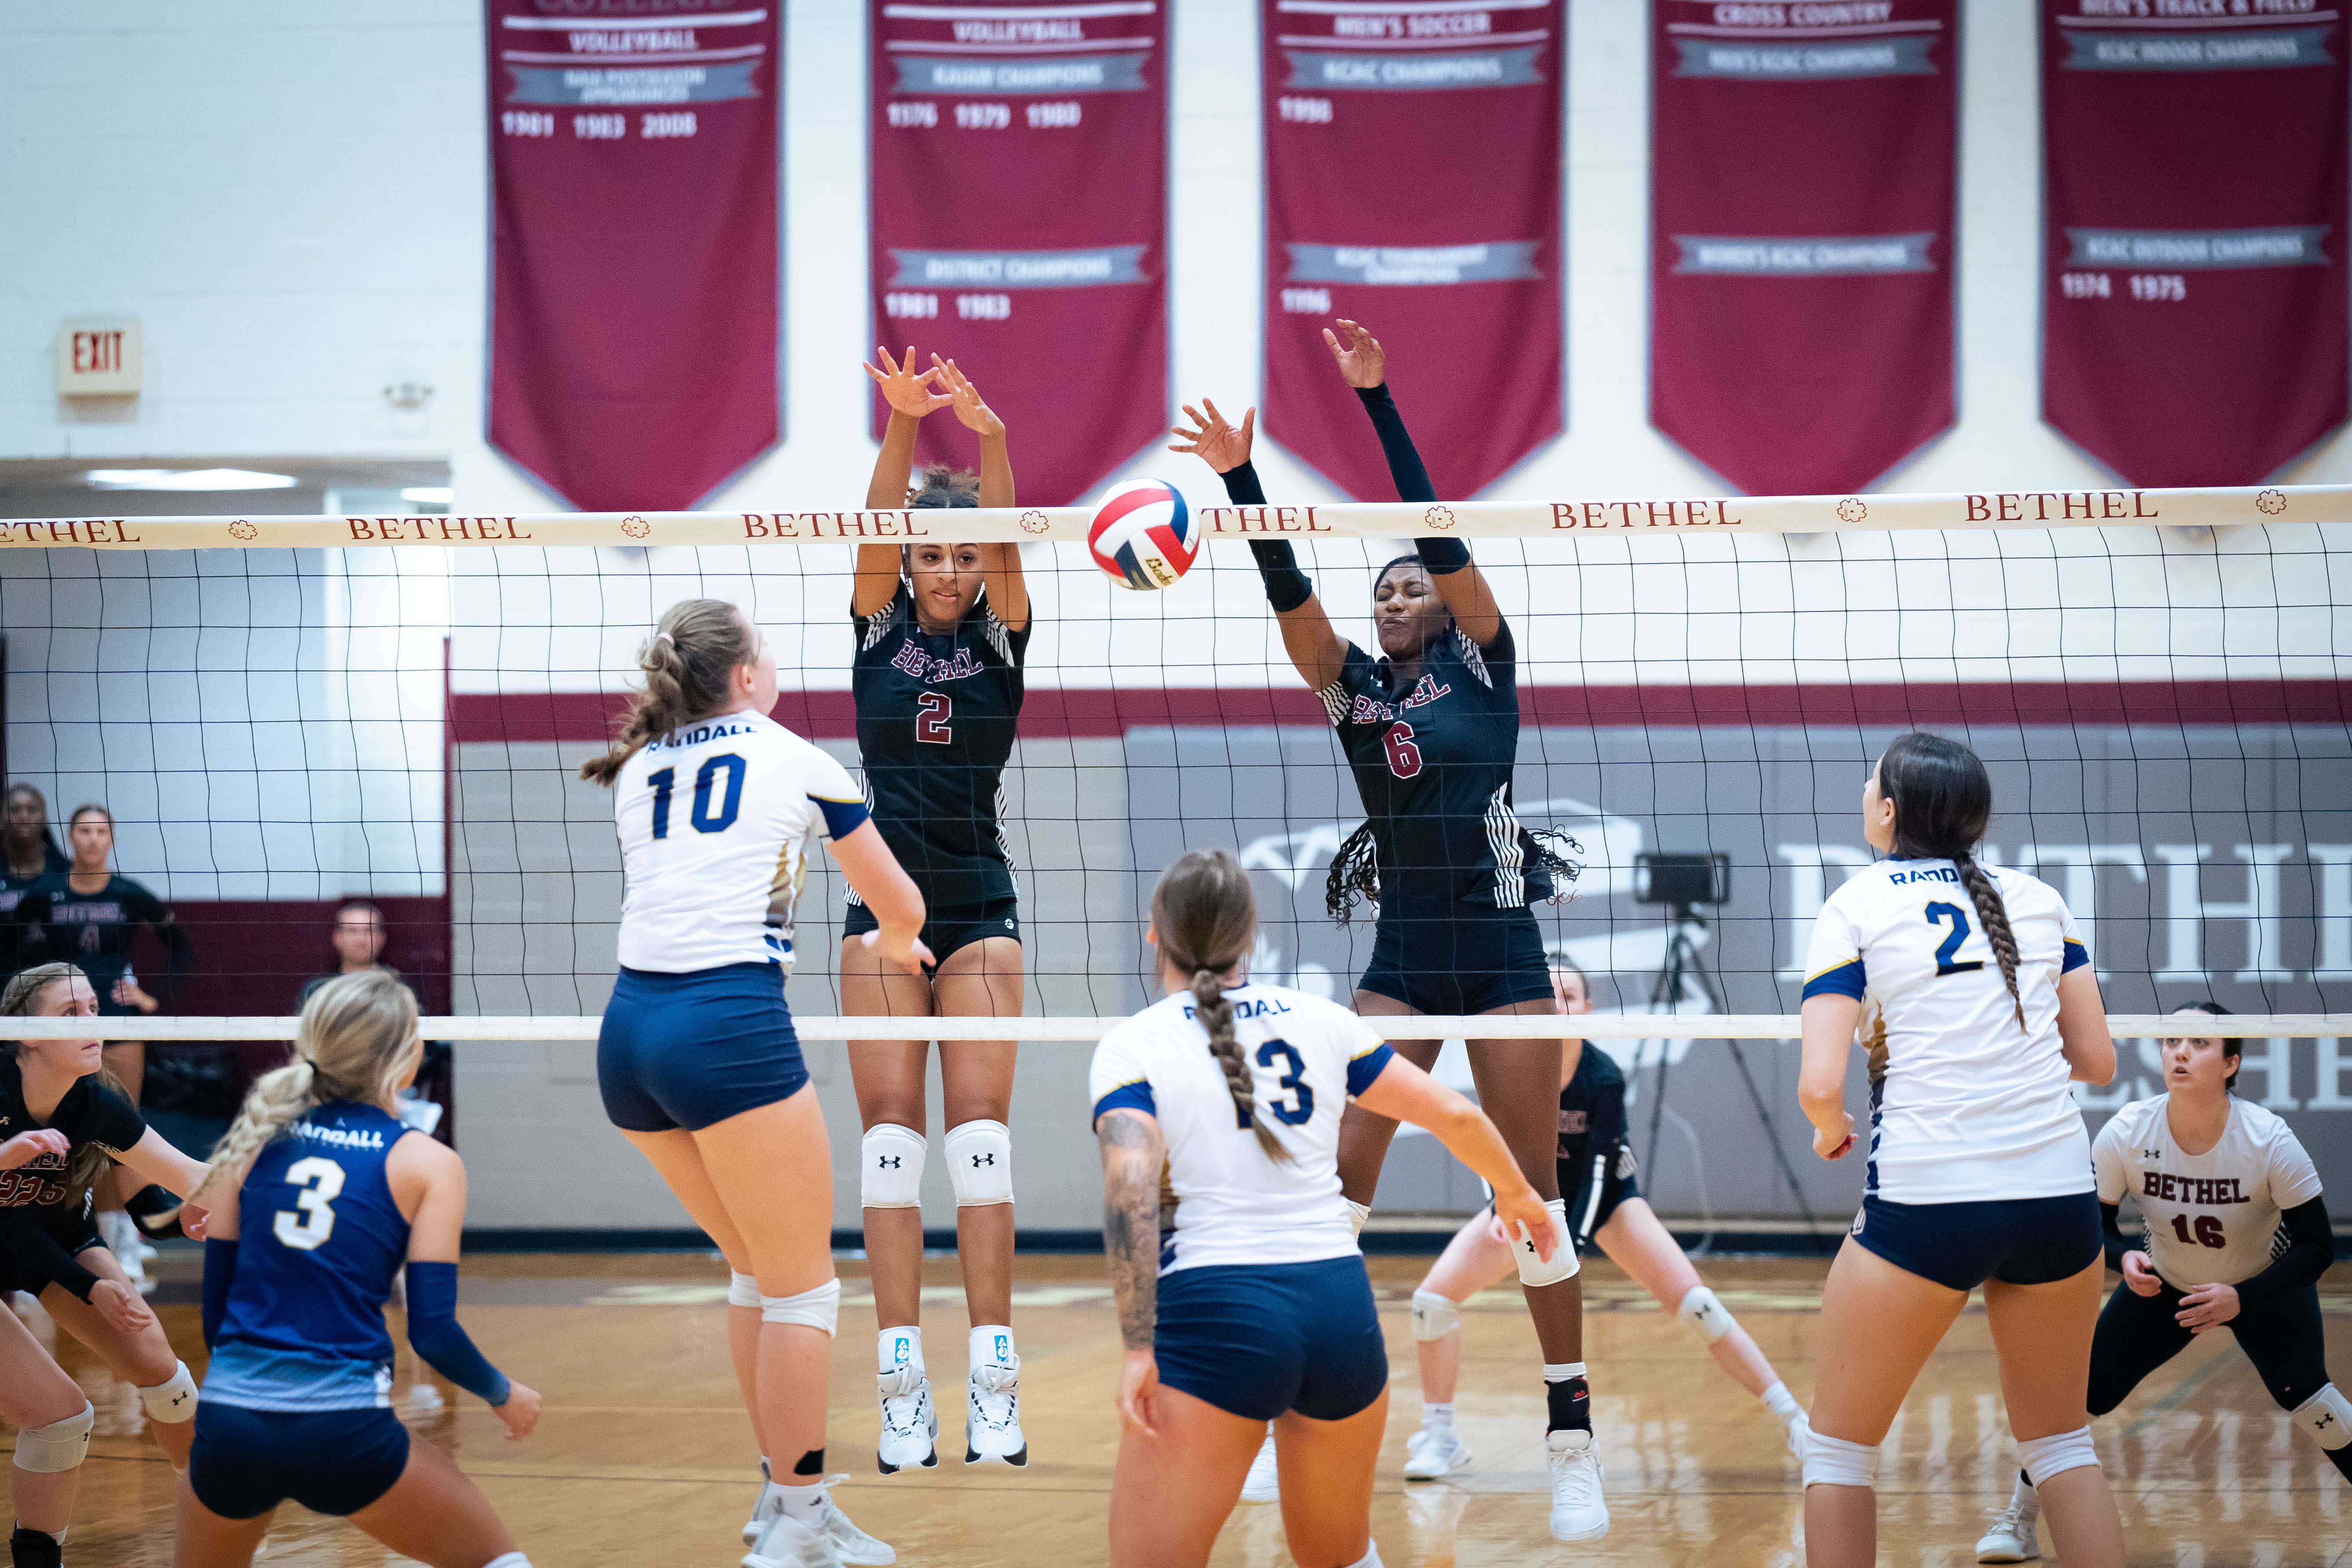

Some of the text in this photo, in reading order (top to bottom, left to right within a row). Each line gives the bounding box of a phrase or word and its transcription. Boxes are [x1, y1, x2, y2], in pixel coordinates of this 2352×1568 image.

[1408, 12, 1490, 36] SOCCER
[1714, 2, 1891, 26] CROSS COUNTRY
[569, 29, 699, 52] VOLLEYBALL
[954, 20, 1085, 41] VOLLEYBALL
[72, 331, 124, 373] EXIT
[1201, 507, 1331, 533] THEL
[1549, 501, 1741, 529] BETHEL
[1964, 491, 2158, 521] BETHEL
[346, 517, 531, 540] BETHEL
[741, 512, 928, 538] BETHEL
[916, 691, 952, 745] 2
[646, 726, 757, 754] RNDALL
[1382, 720, 1423, 779] 6
[647, 752, 747, 841] 10
[2143, 1171, 2250, 1205] BETHEL
[273, 1155, 347, 1251] 3
[2171, 1213, 2227, 1250] 16
